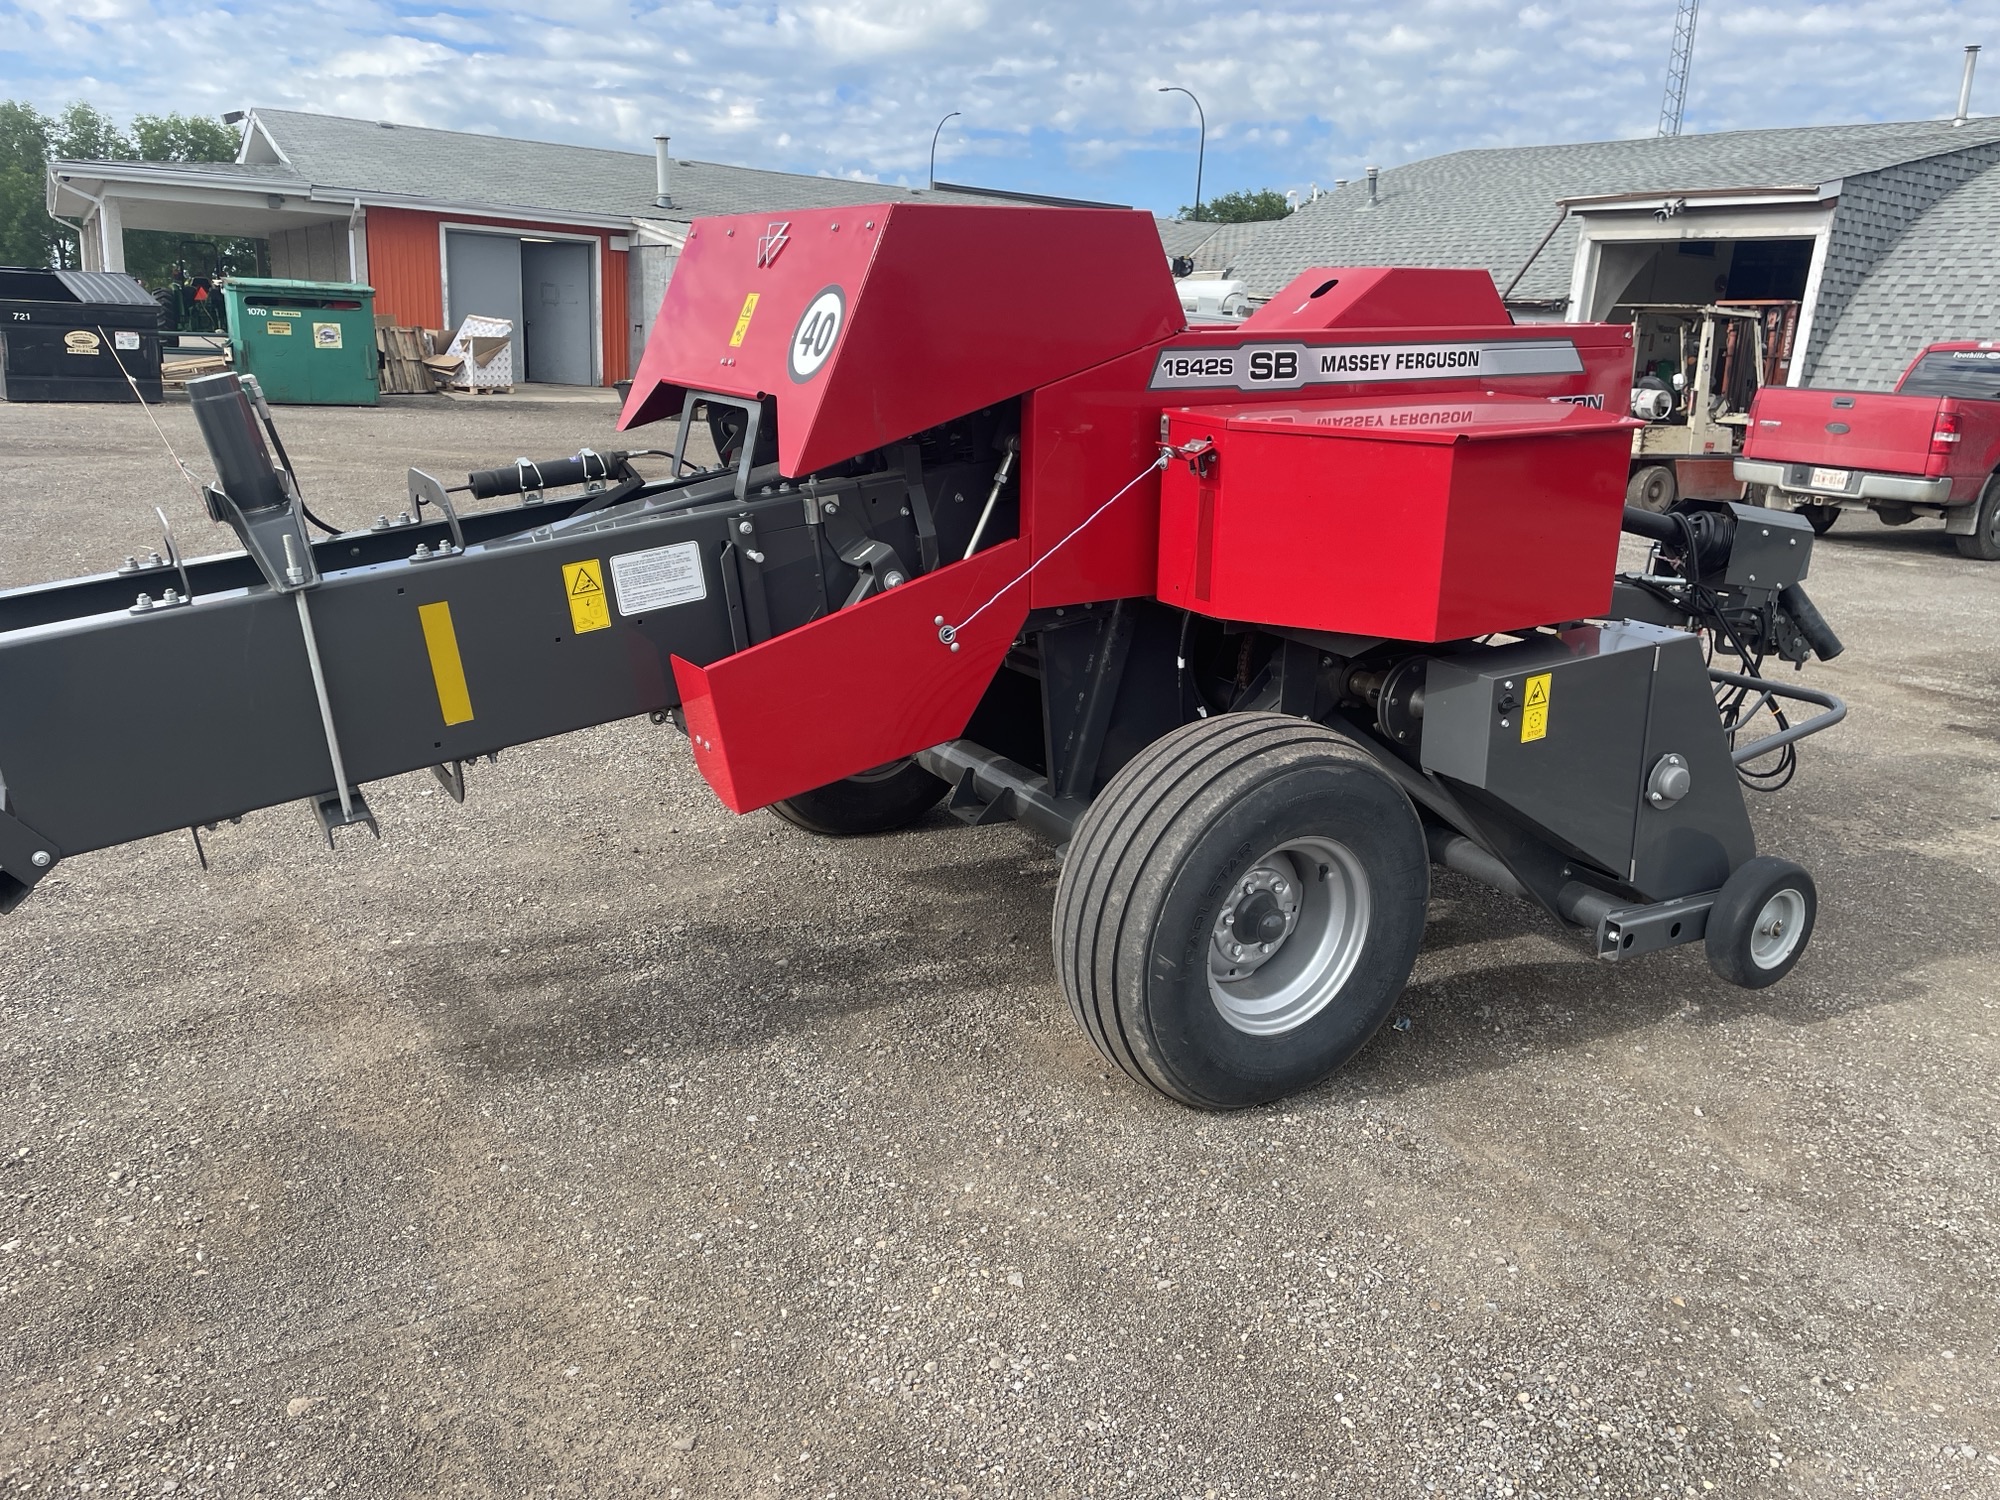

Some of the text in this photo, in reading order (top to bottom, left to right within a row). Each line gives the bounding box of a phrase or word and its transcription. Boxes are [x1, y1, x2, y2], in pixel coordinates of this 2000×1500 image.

[12, 312, 30, 321] 721
[247, 308, 267, 316] 1070
[799, 310, 836, 357] 40
[1783, 318, 1793, 357] NISSAN
[1162, 350, 1480, 380] 1842S SB MASSEY FERGUSON
[1953, 351, 1986, 359] Foothills
[1527, 728, 1543, 738] STOP
[1185, 841, 1252, 965] CARLSTAR
